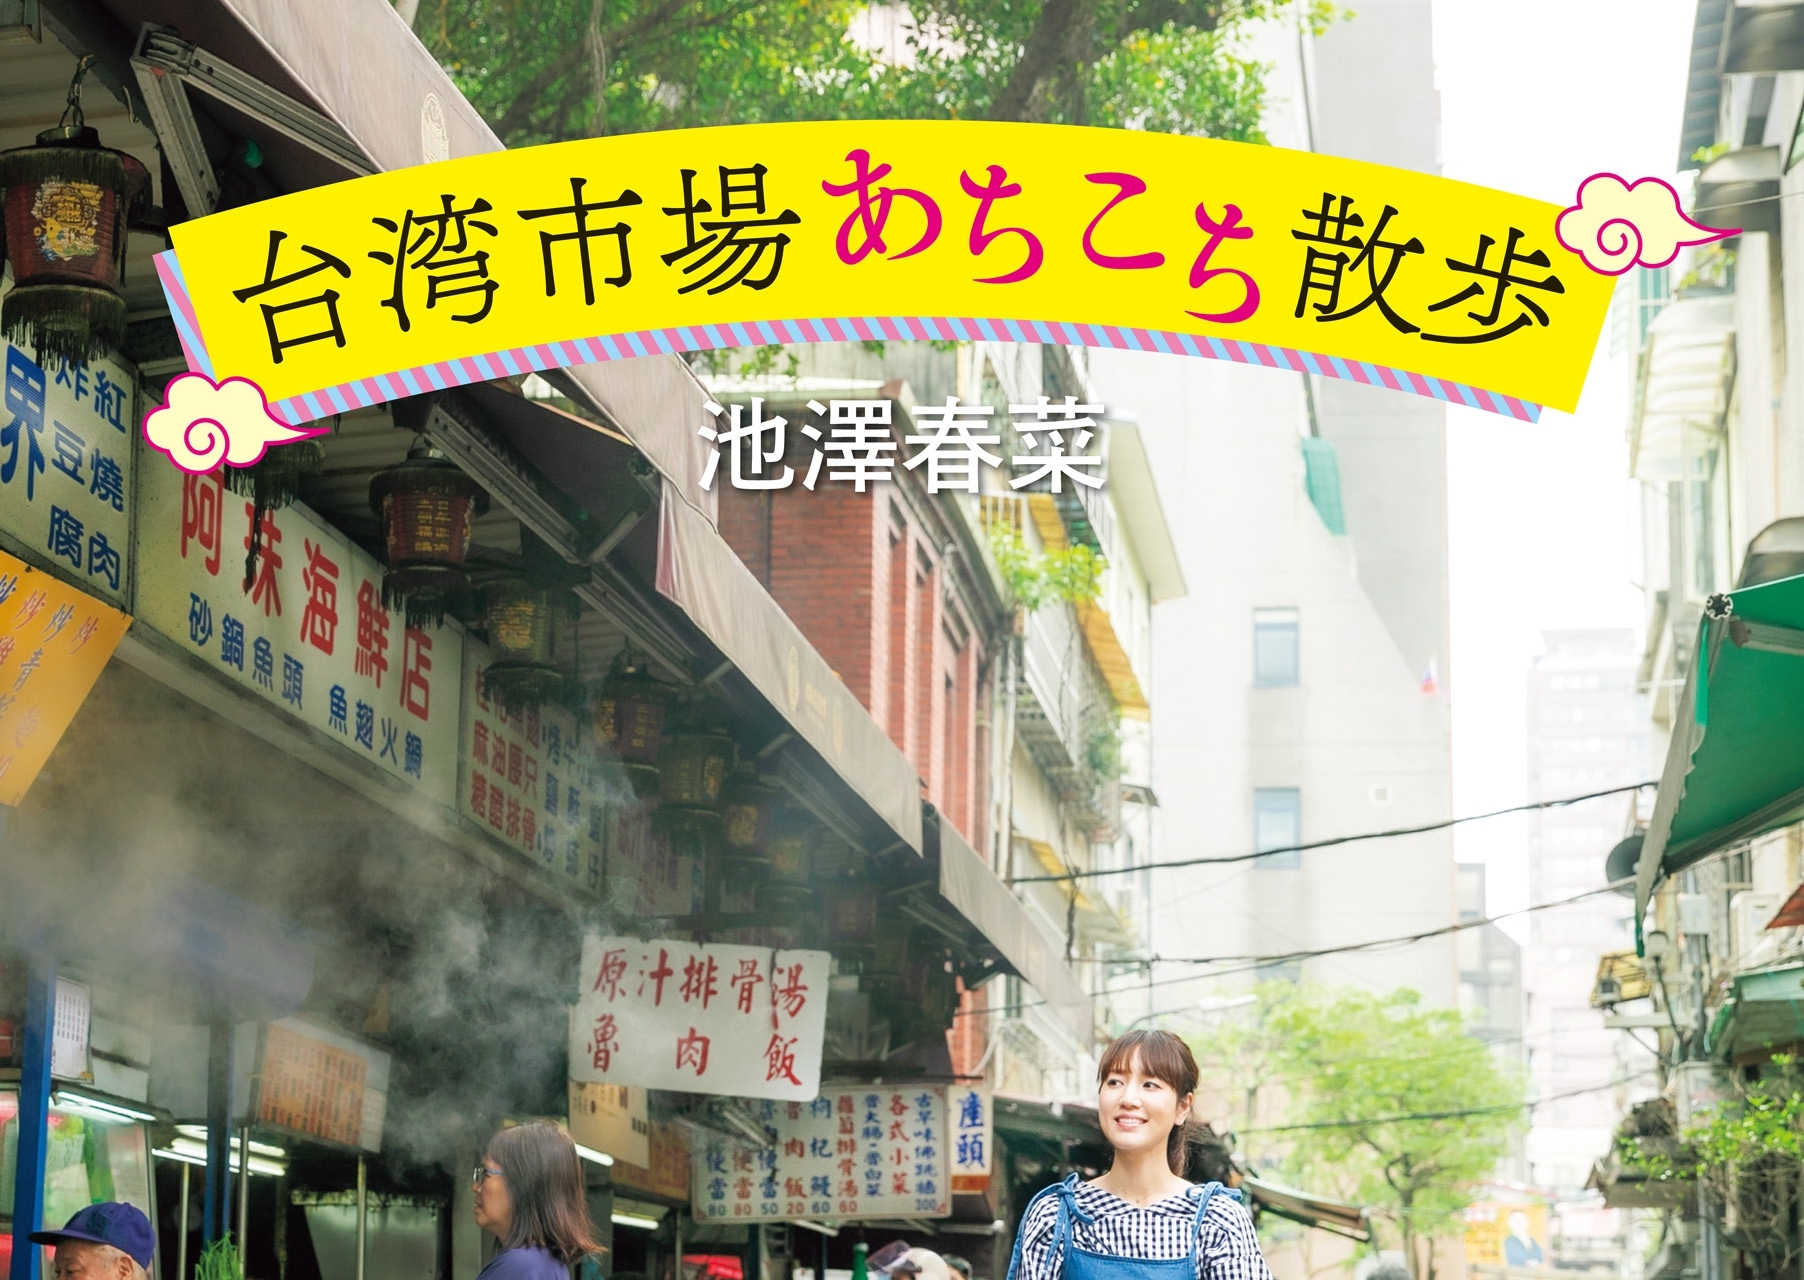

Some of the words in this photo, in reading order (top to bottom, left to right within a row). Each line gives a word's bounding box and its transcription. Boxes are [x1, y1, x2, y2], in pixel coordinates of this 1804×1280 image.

[1, 344, 46, 502] 界
[88, 370, 128, 591] 紅燒肉
[181, 470, 433, 722] 阿珠海鮮店
[188, 592, 304, 711] 砂鍋魚頭
[328, 684, 423, 779] 魚翅火鍋
[592, 948, 809, 1019] 原汁排骨湯
[587, 1013, 803, 1086] 魯肉飯
[888, 1094, 911, 1195] 各式小菜
[708, 1203, 727, 1216] 80
[734, 1203, 752, 1216] 80
[786, 1202, 805, 1214] 20
[812, 1201, 831, 1214] 60
[839, 1200, 858, 1214] 60
